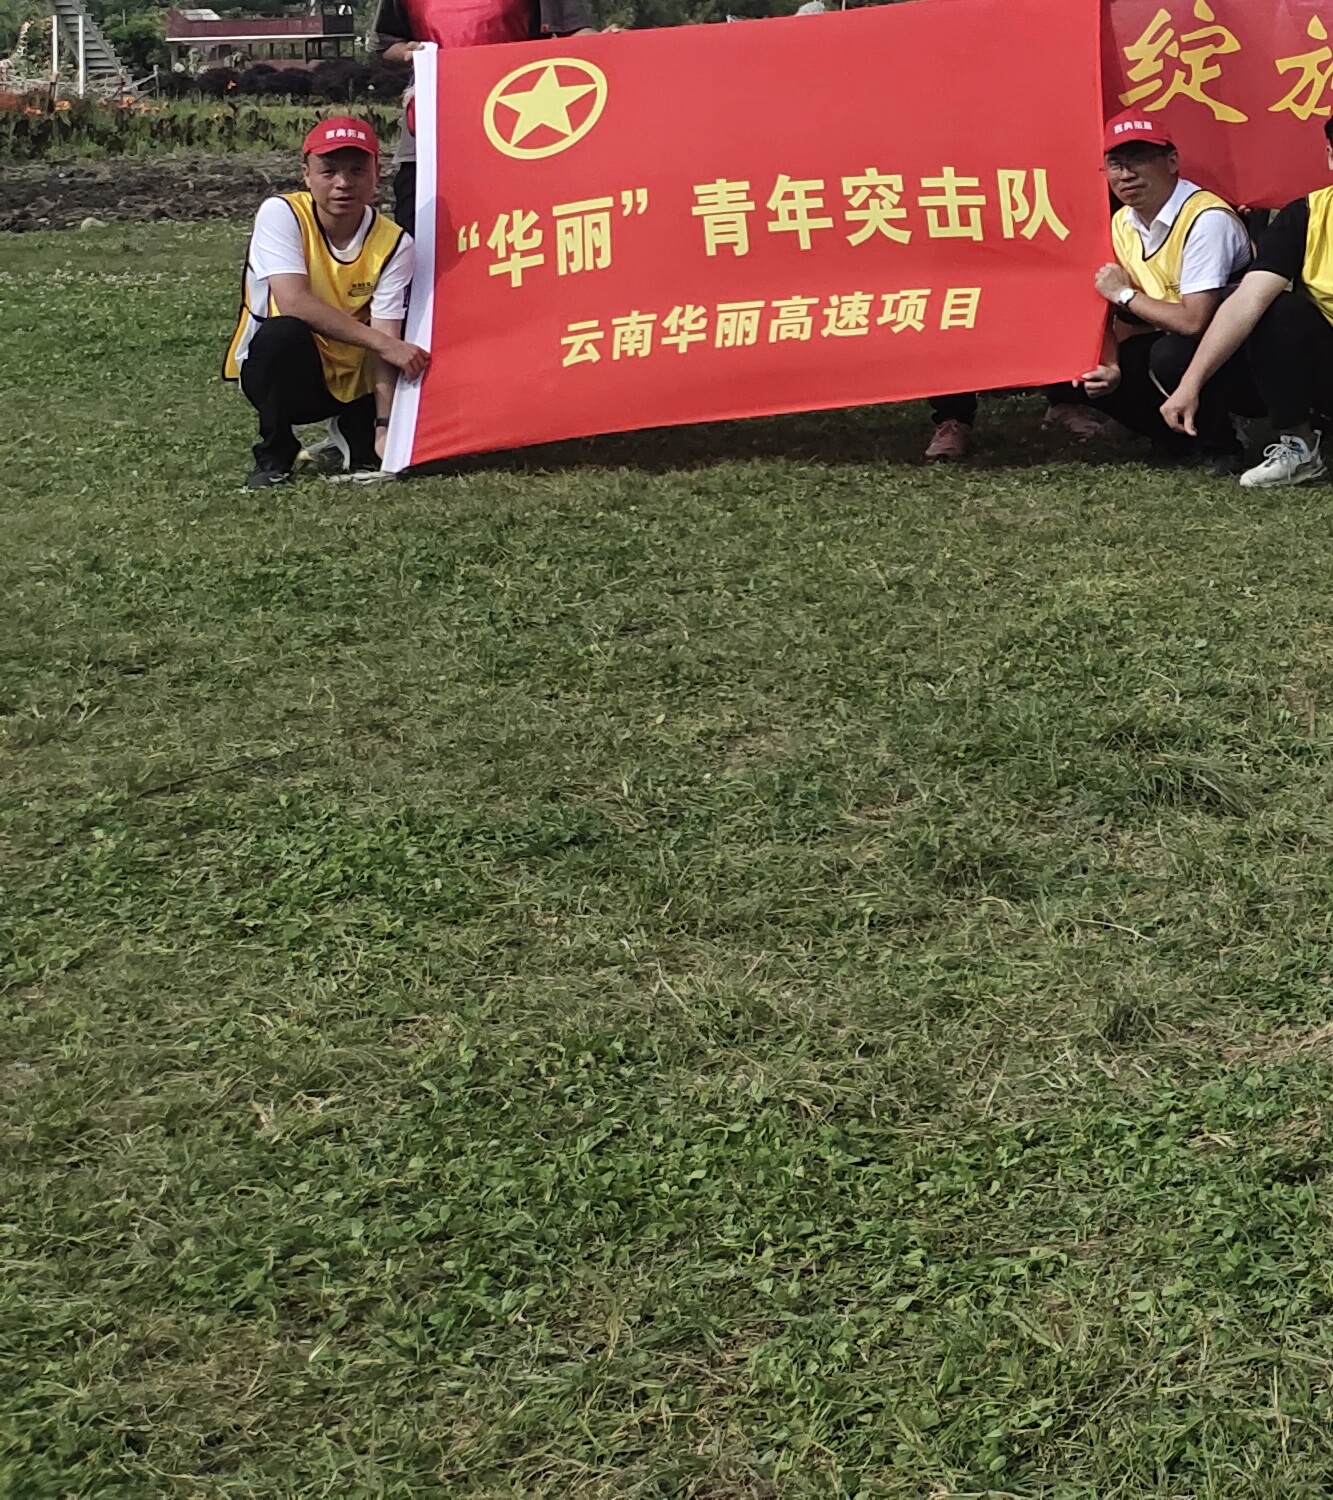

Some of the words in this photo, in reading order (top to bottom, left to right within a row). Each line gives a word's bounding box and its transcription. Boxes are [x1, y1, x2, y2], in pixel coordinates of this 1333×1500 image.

[561, 287, 982, 369] 云南华丽高速项目
